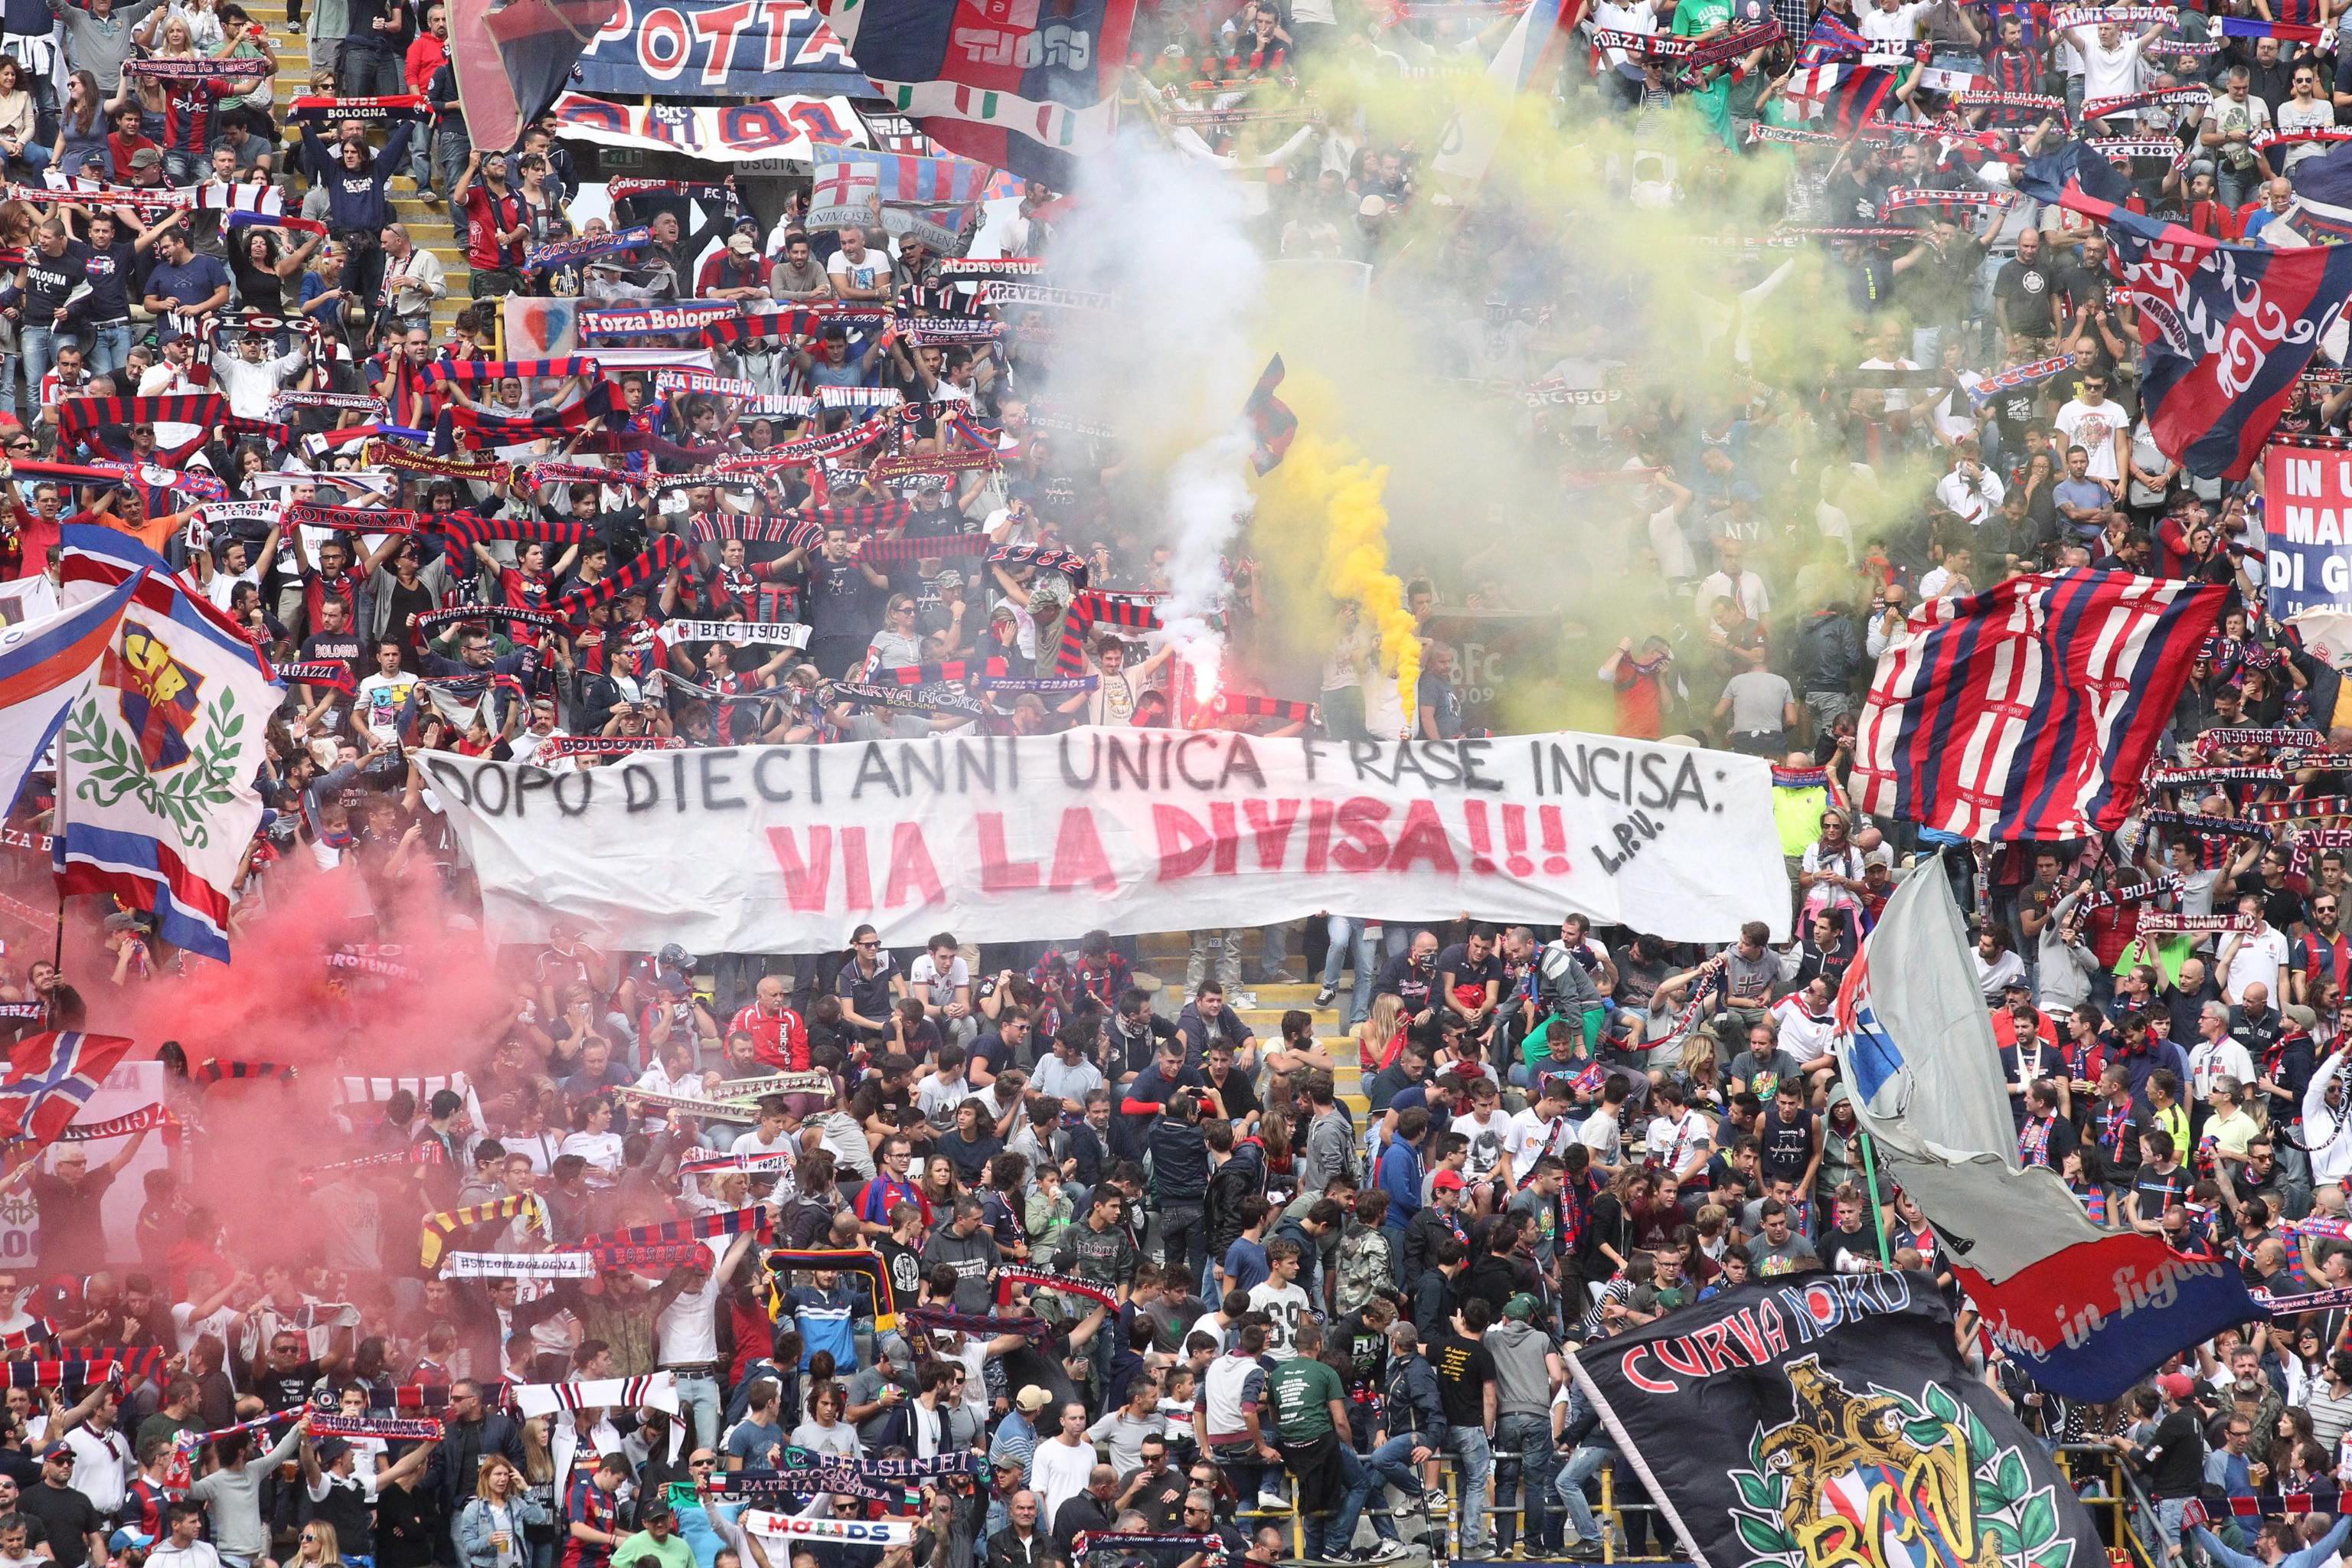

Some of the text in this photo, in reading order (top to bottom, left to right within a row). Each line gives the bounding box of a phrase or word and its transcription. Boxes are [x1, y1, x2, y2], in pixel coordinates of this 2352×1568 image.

[1592, 32, 1645, 54] FORZA
[217, 61, 259, 74] 1909
[172, 98, 208, 113] FAAC
[328, 108, 387, 118] BOLOGNA
[611, 177, 666, 197] Bologna
[585, 308, 737, 332] Forza Bologna
[853, 314, 880, 322] 1909
[894, 318, 972, 333] BOLOGNA
[387, 454, 491, 477] Sempre Presenti
[2285, 459, 2321, 498] IN
[207, 502, 280, 515] BOLOGNA
[291, 508, 413, 528] BOLOGNA
[988, 546, 1083, 575] 1982
[2269, 550, 2305, 592] DI
[700, 623, 791, 639] BFC 1909
[315, 645, 359, 658] BOLOGNA
[831, 681, 912, 701] CURVA
[991, 680, 1026, 691] TOTAL
[885, 699, 937, 710] BOLOGNA
[560, 739, 657, 753] BOLOGNA
[428, 756, 593, 817] DOPO
[623, 747, 822, 814] DIECI
[851, 737, 1018, 800] ANNI
[1057, 728, 1268, 794] UNICA
[1300, 738, 1504, 792] FRASE
[766, 796, 1572, 913] VIA LA DIVISA!!!
[2184, 914, 2228, 929] SIAMO
[1827, 956, 1849, 966] BFC
[758, 1155, 782, 1171] FORZA
[1620, 1269, 1911, 1394] CURVA NORD
[2055, 1303, 2107, 1350] in
[818, 1451, 970, 1478] FELSINEI
[776, 1468, 862, 1486] BOLOGNA
[740, 1479, 892, 1503] PATRIA NOSTRA
